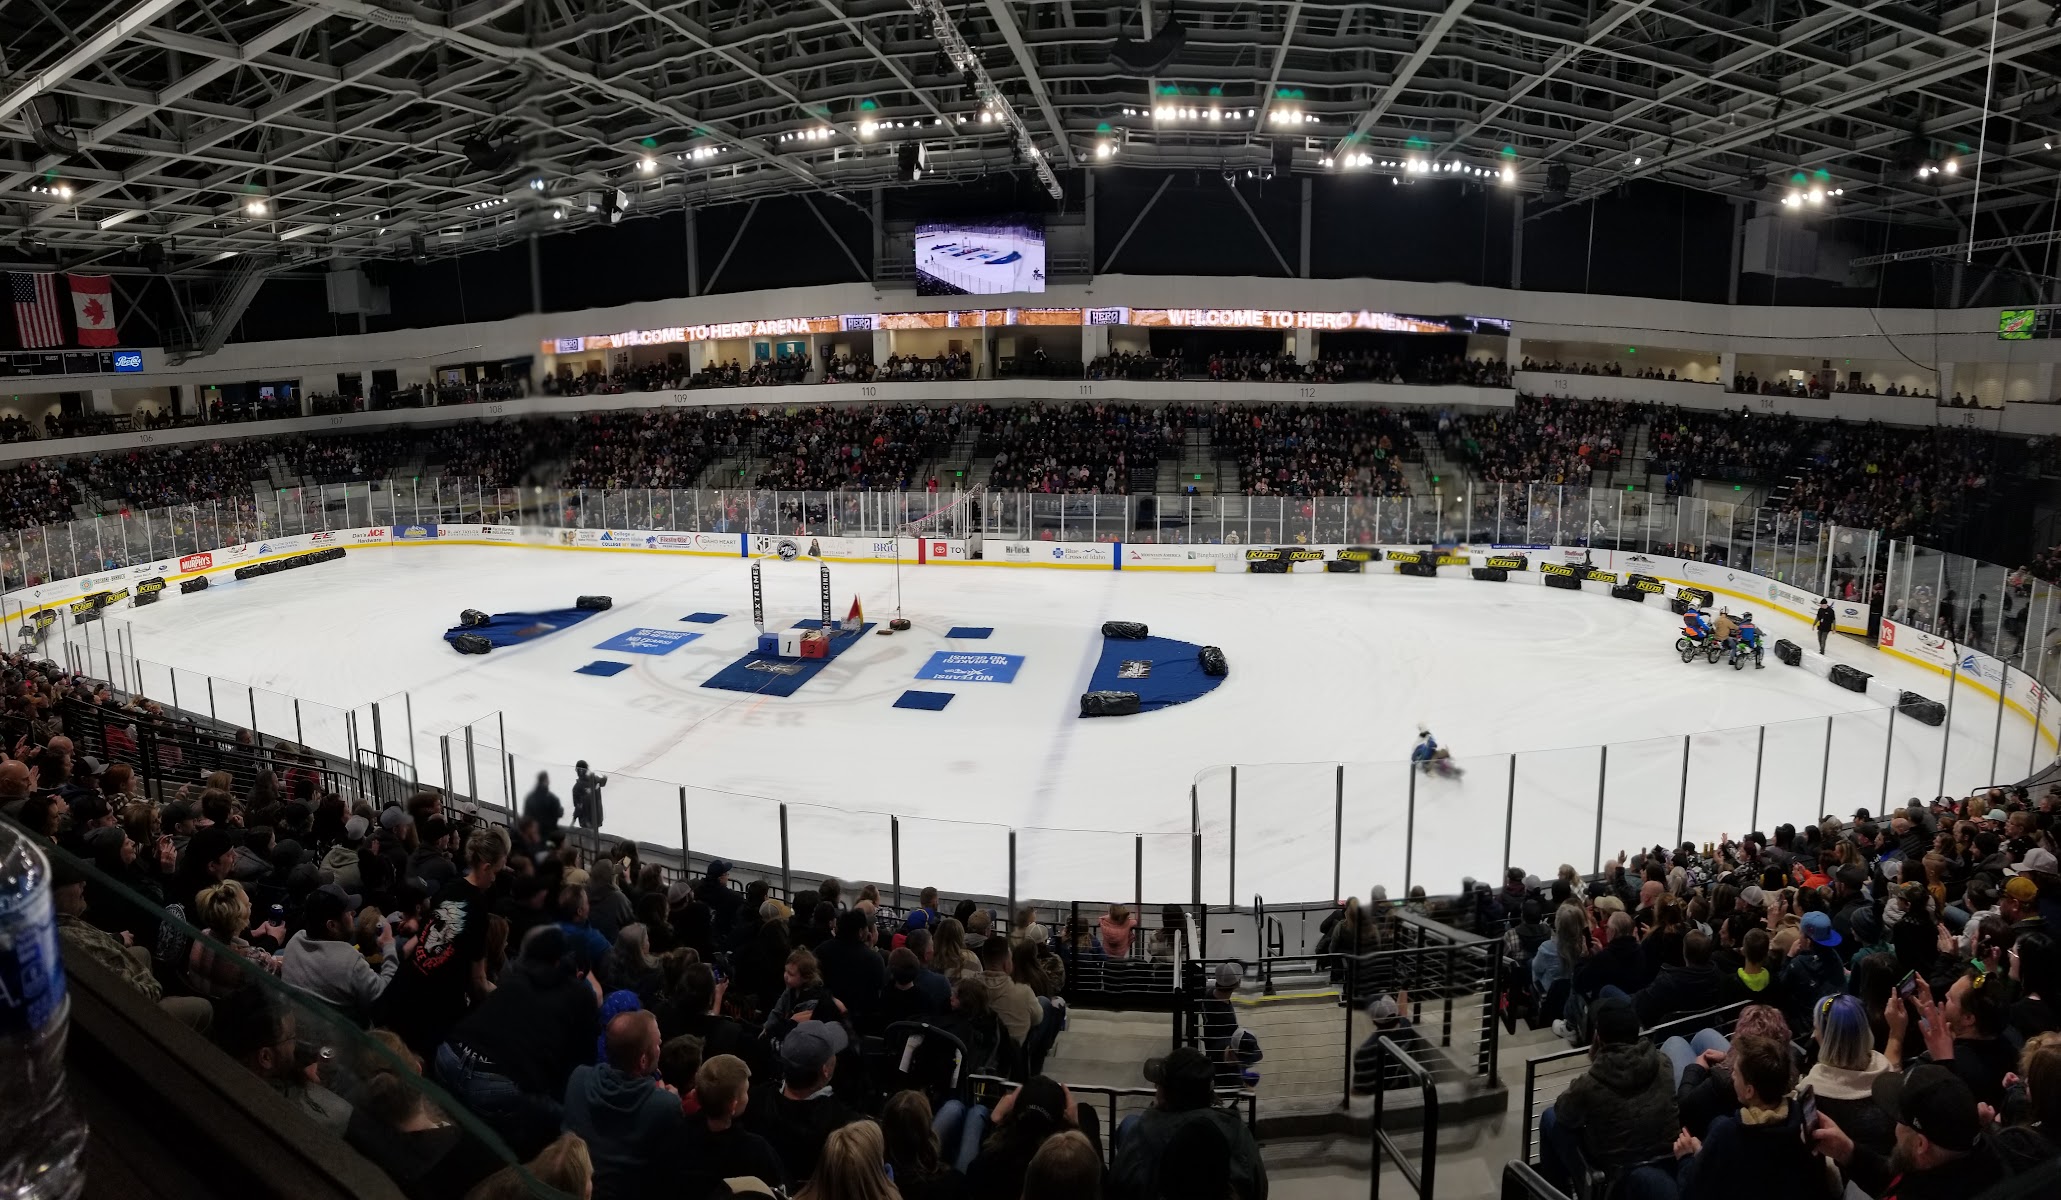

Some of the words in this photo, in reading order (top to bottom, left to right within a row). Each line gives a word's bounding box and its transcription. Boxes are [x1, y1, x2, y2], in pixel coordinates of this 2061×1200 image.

[1167, 309, 1264, 326] WELCOME
[1269, 310, 1294, 327] TO
[1298, 312, 1352, 330] HERO
[1356, 310, 1418, 332] ARENA
[610, 326, 686, 348] WELCOME
[686, 325, 706, 342] TO
[710, 322, 755, 338] HERO
[756, 318, 810, 336] ARENA
[1554, 380, 1568, 389] 113
[862, 386, 876, 396] 110
[1080, 385, 1092, 394] 111
[1300, 388, 1316, 398] 112
[674, 394, 688, 403] 109
[1761, 399, 1774, 408] 114
[489, 406, 502, 414] 108
[330, 417, 343, 425] 107
[140, 434, 153, 443] 106
[1390, 553, 1418, 562] Klim
[1489, 558, 1517, 567] Klim
[1543, 565, 1570, 575] Klim
[1589, 572, 1614, 581] Klim
[140, 583, 161, 593] Klim
[1639, 582, 1661, 591] Klim
[107, 590, 127, 602] Klim
[74, 600, 93, 612] Klim
[765, 642, 772, 651] 3
[786, 641, 792, 653] 1
[807, 645, 815, 654] 2
[416, 946, 427, 962] LEE
